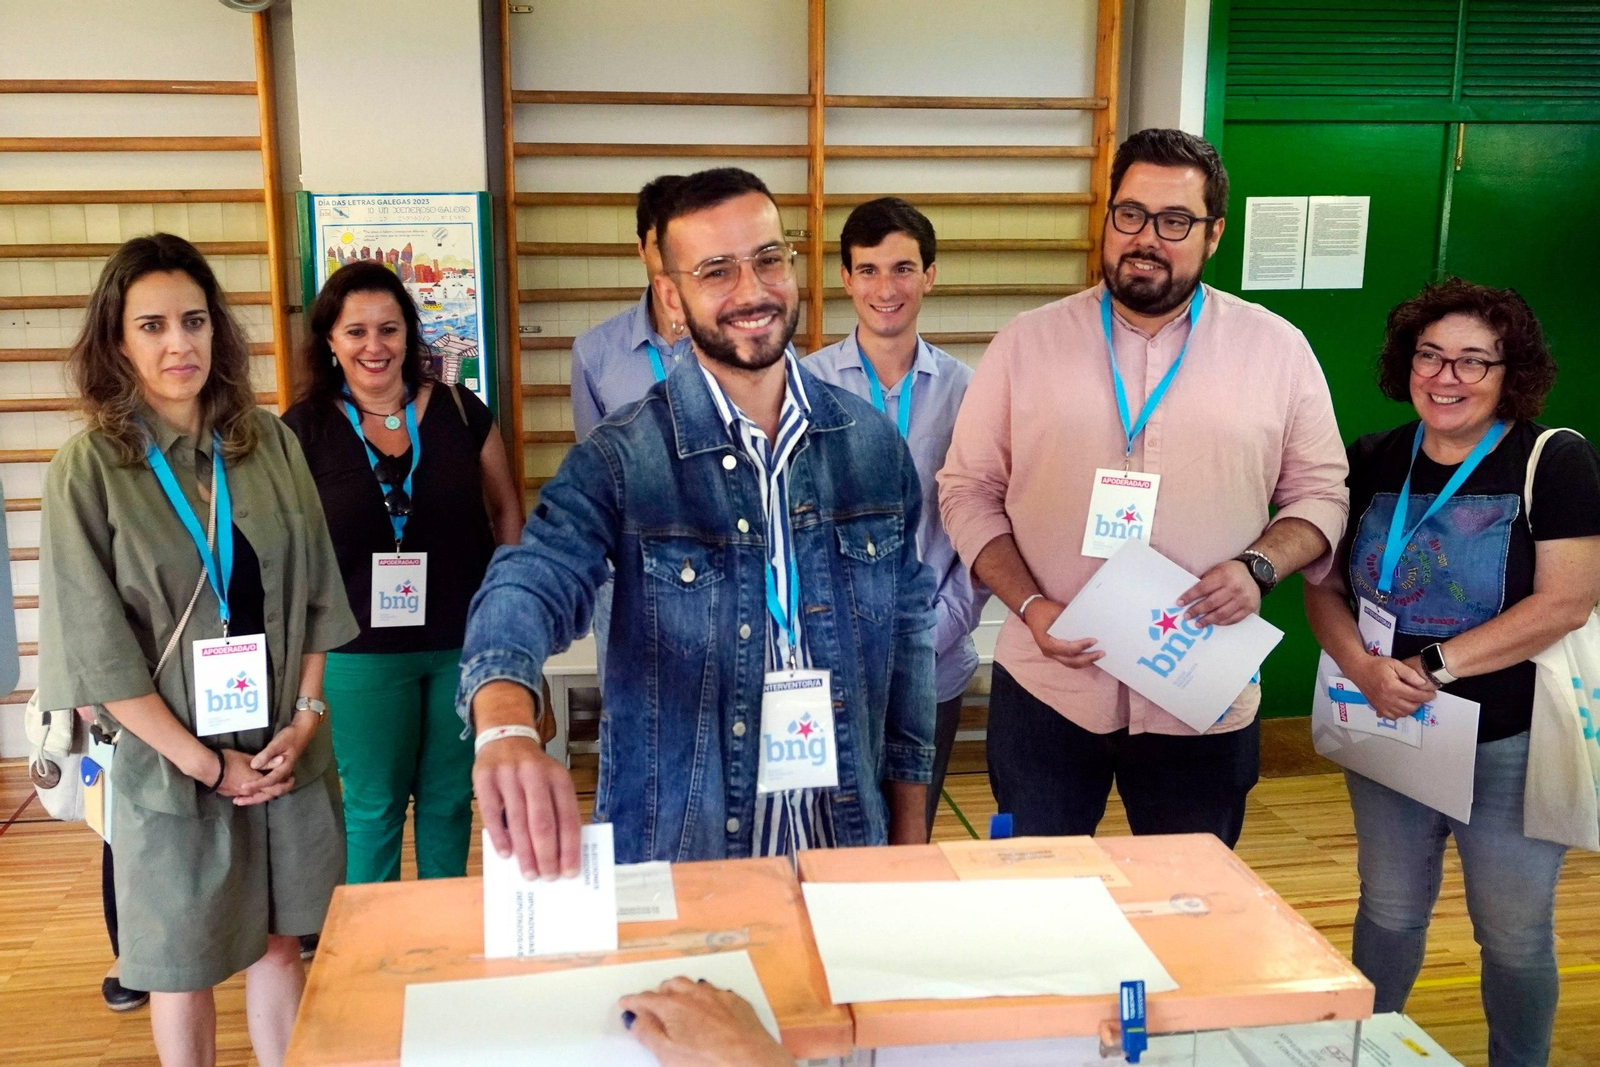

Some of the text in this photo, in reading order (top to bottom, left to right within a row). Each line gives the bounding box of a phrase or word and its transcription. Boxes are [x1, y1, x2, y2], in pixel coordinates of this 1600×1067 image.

[318, 199, 330, 207] DÍA
[393, 206, 437, 214] XENEROSO
[1102, 477, 1151, 488] APODERADA/O
[1095, 514, 1143, 540] bng
[379, 591, 419, 613] bng
[203, 644, 256, 655] APODERADA/O
[1136, 617, 1214, 678] bng
[763, 679, 821, 692] NTERVENTOR/A
[205, 689, 258, 713] bng
[763, 735, 826, 766] bng
